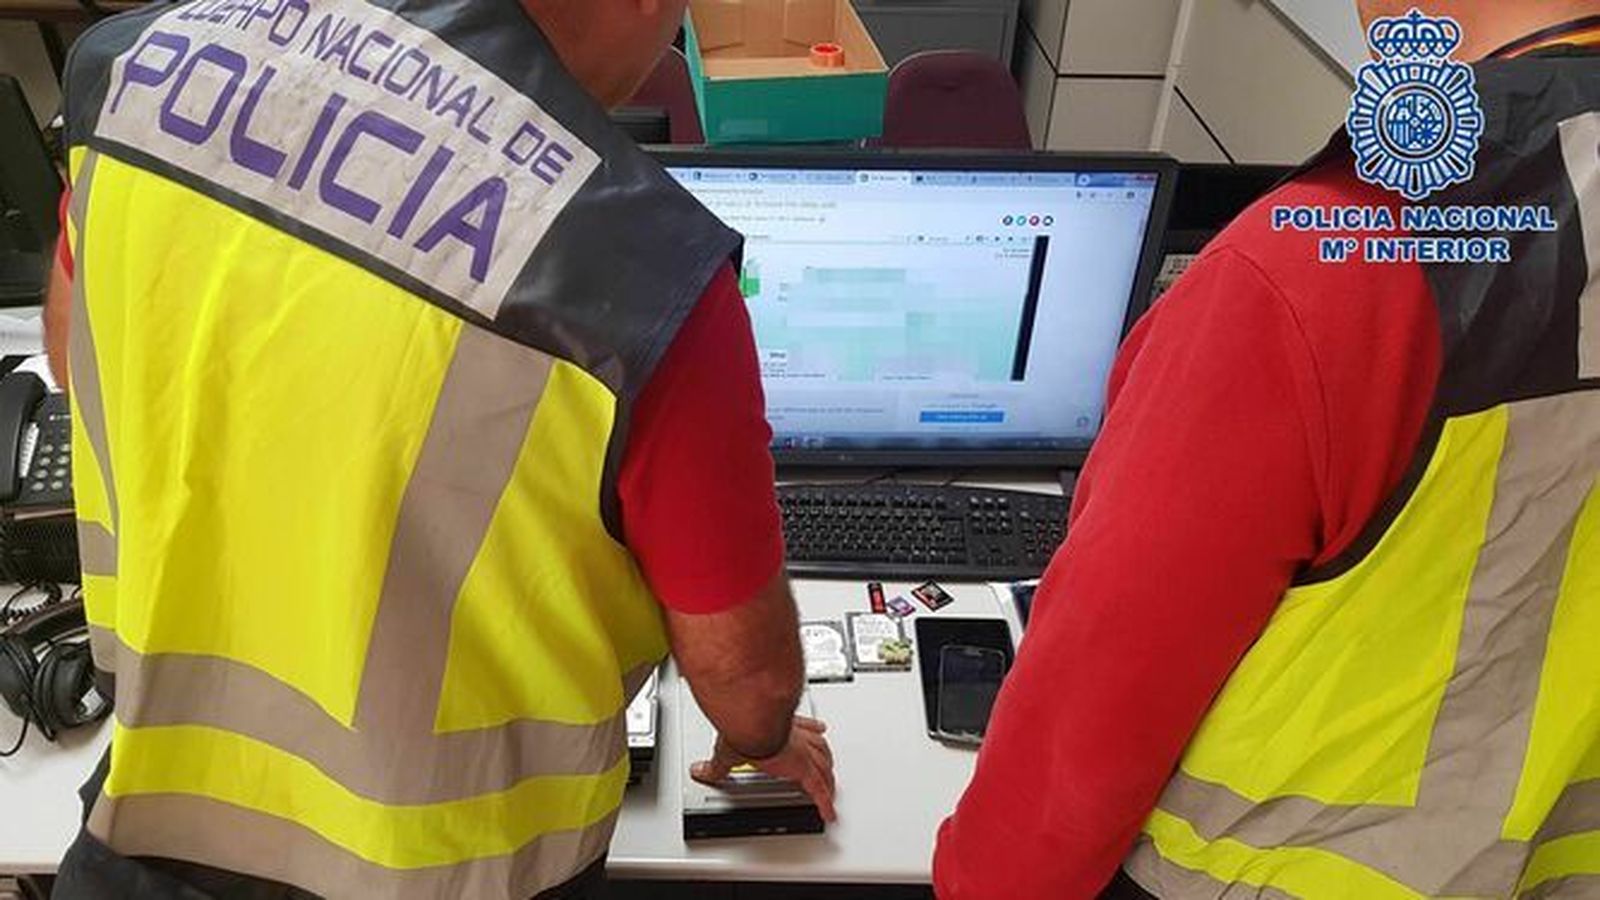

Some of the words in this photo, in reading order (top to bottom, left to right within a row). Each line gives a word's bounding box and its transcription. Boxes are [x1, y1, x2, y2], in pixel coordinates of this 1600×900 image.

[110, 30, 510, 284] POLICIA
[301, 13, 498, 145] NACIONAL
[501, 121, 575, 187] DE
